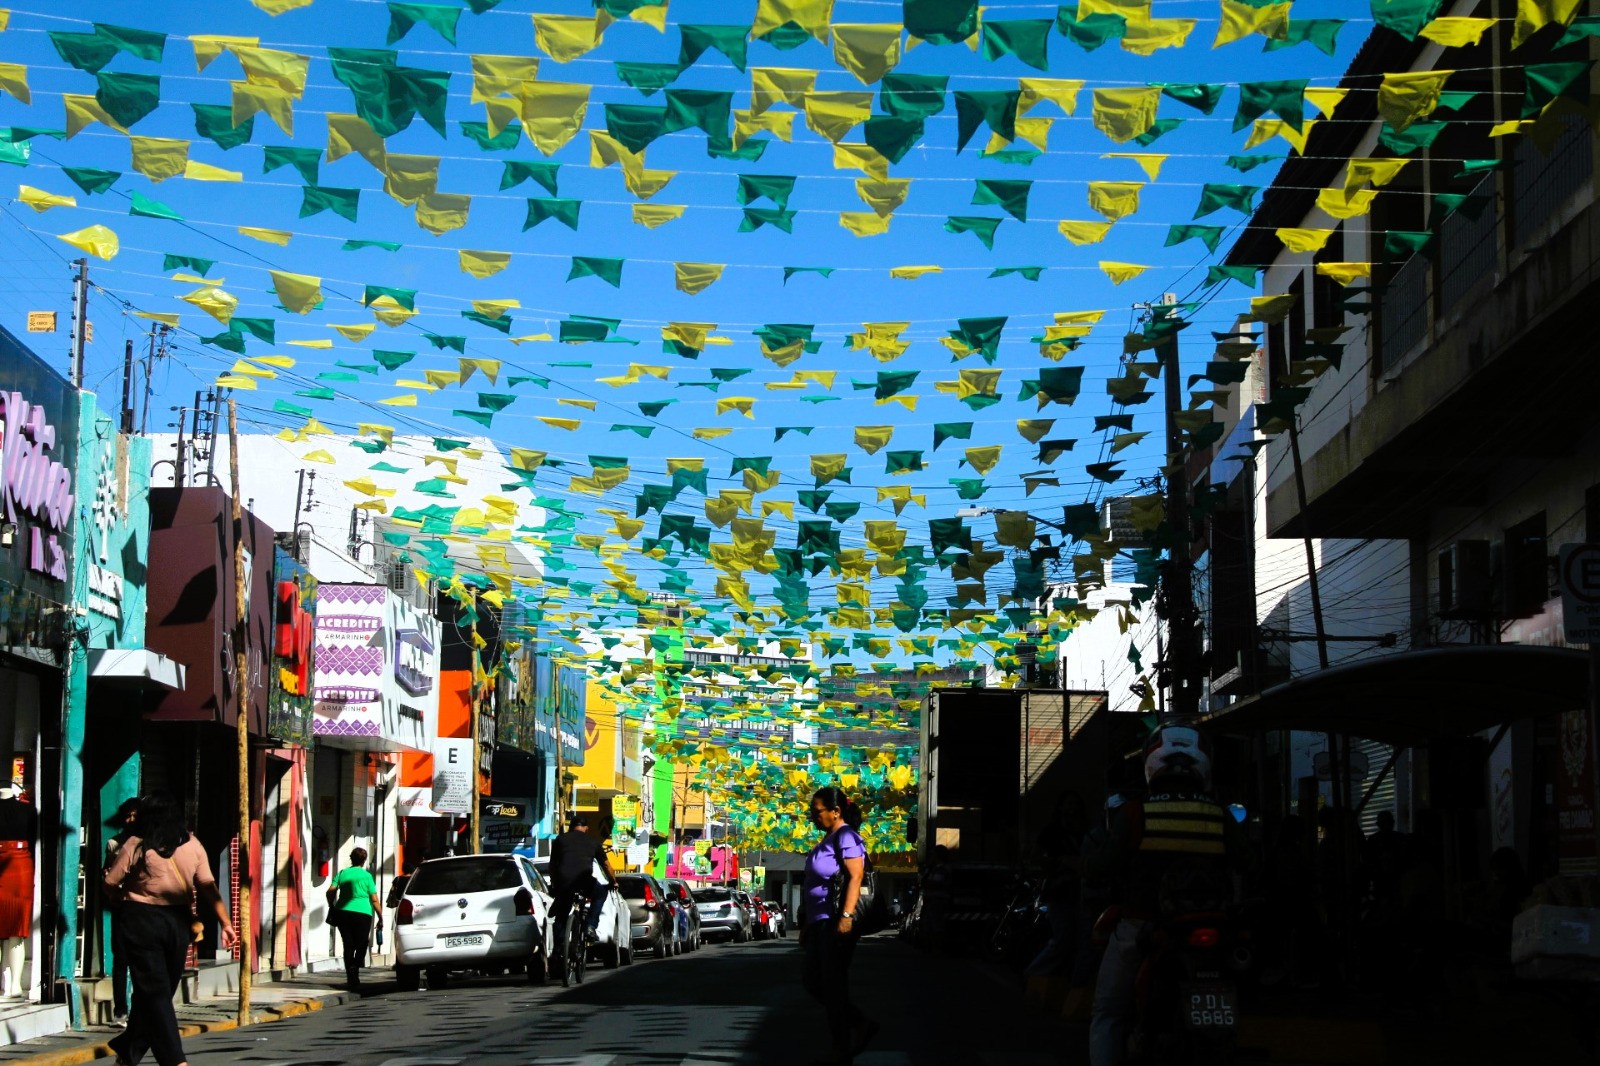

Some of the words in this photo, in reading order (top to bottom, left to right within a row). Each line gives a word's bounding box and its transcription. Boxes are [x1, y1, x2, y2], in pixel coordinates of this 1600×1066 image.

[317, 618, 378, 628] ACREDITE
[314, 689, 375, 700] ACREDITE
[448, 748, 458, 764] E
[1191, 994, 1232, 1009] PDL
